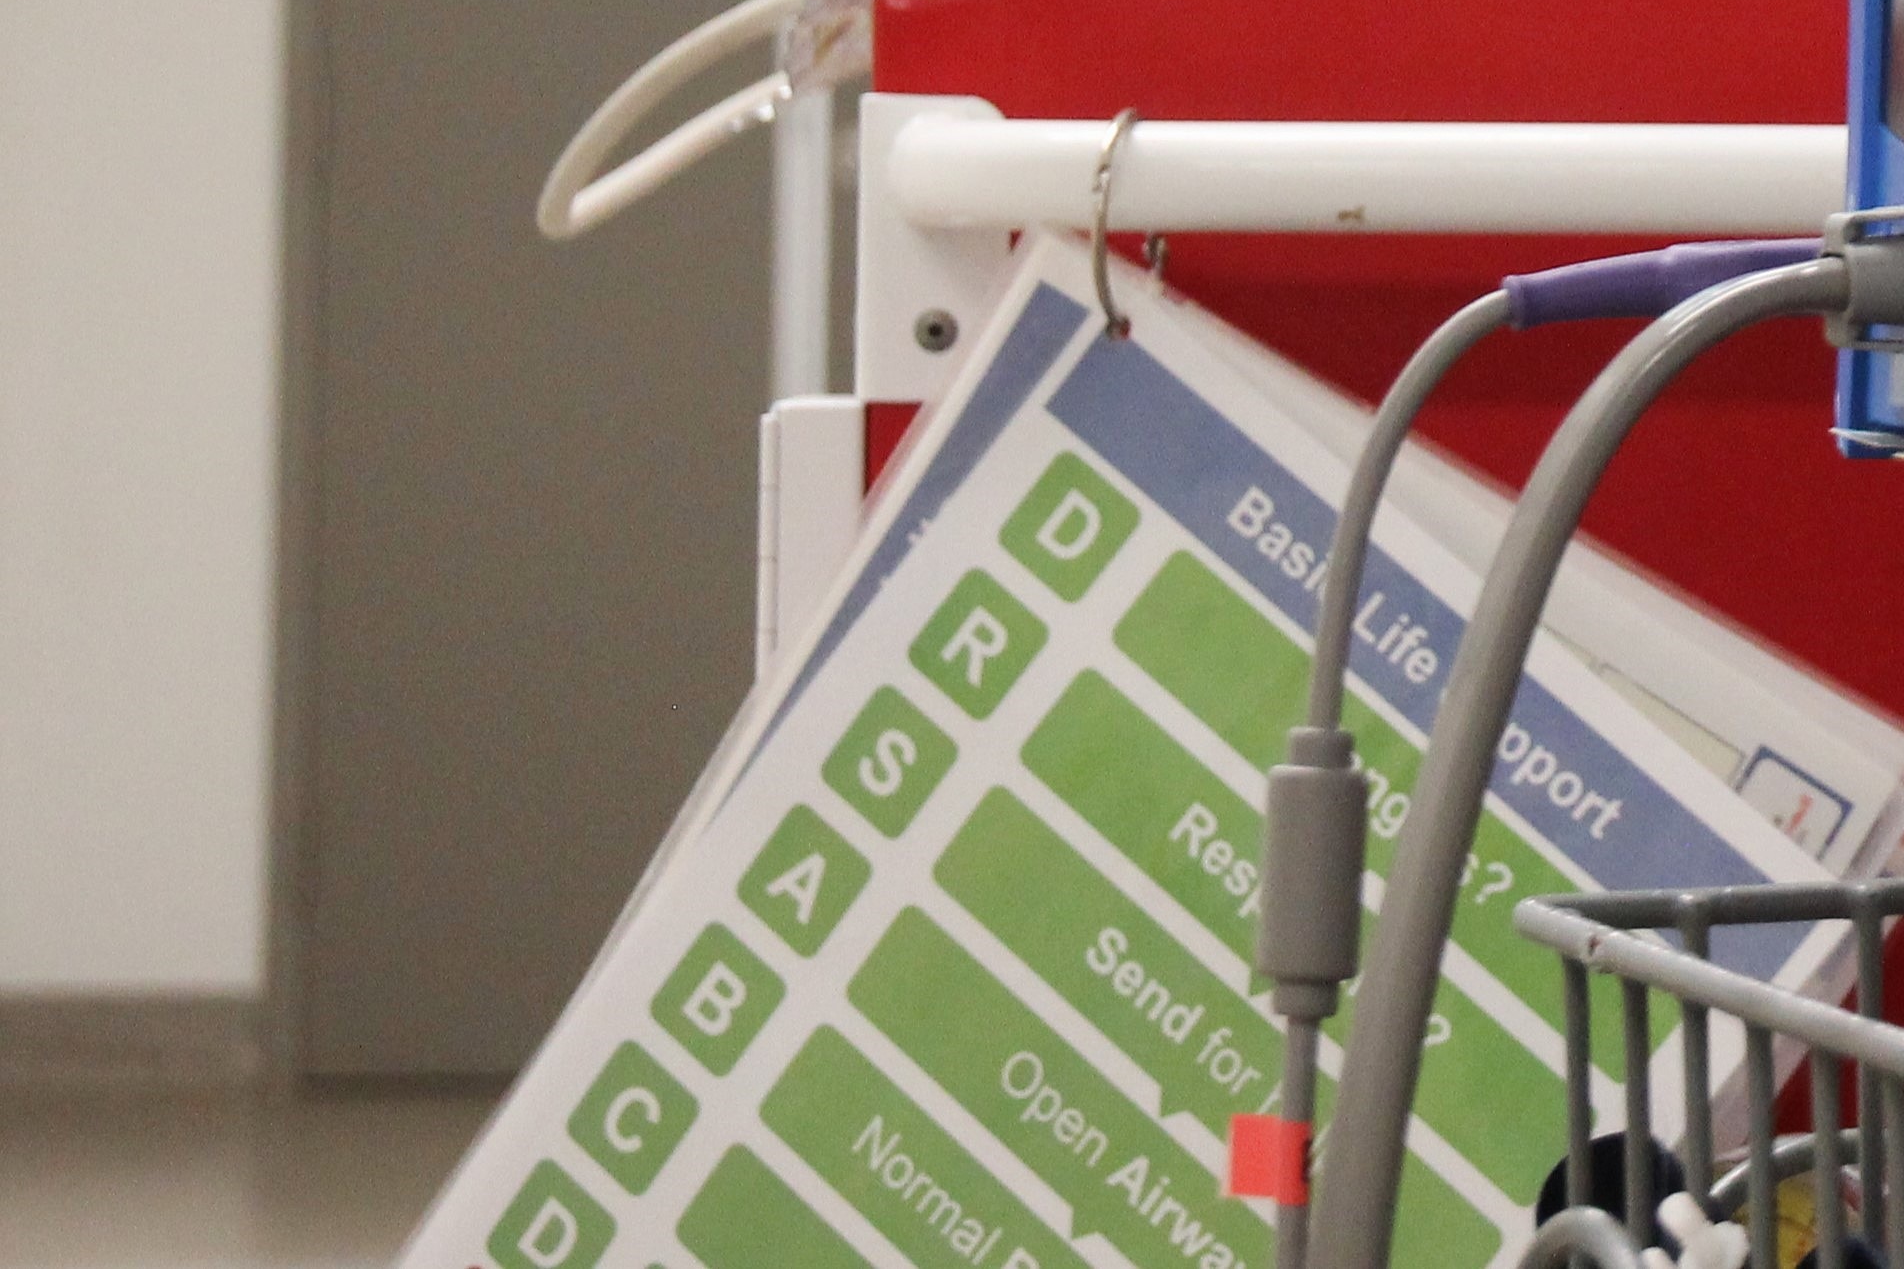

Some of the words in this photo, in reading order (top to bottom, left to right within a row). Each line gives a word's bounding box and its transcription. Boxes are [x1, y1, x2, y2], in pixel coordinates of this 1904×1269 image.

[1036, 490, 1101, 560] D
[1226, 485, 1332, 601] Basi
[1353, 591, 1439, 684] Life
[941, 606, 1009, 686] R
[858, 728, 917, 797] S
[766, 852, 826, 925] A
[682, 960, 747, 1036] B
[1085, 927, 1206, 1045] Send
[1195, 1027, 1263, 1096] for
[603, 1086, 661, 1153] C
[851, 1114, 1002, 1265] Normal
[1001, 1050, 1111, 1168] Open
[1106, 1154, 1248, 1269] Airwa
[517, 1196, 578, 1269] D
